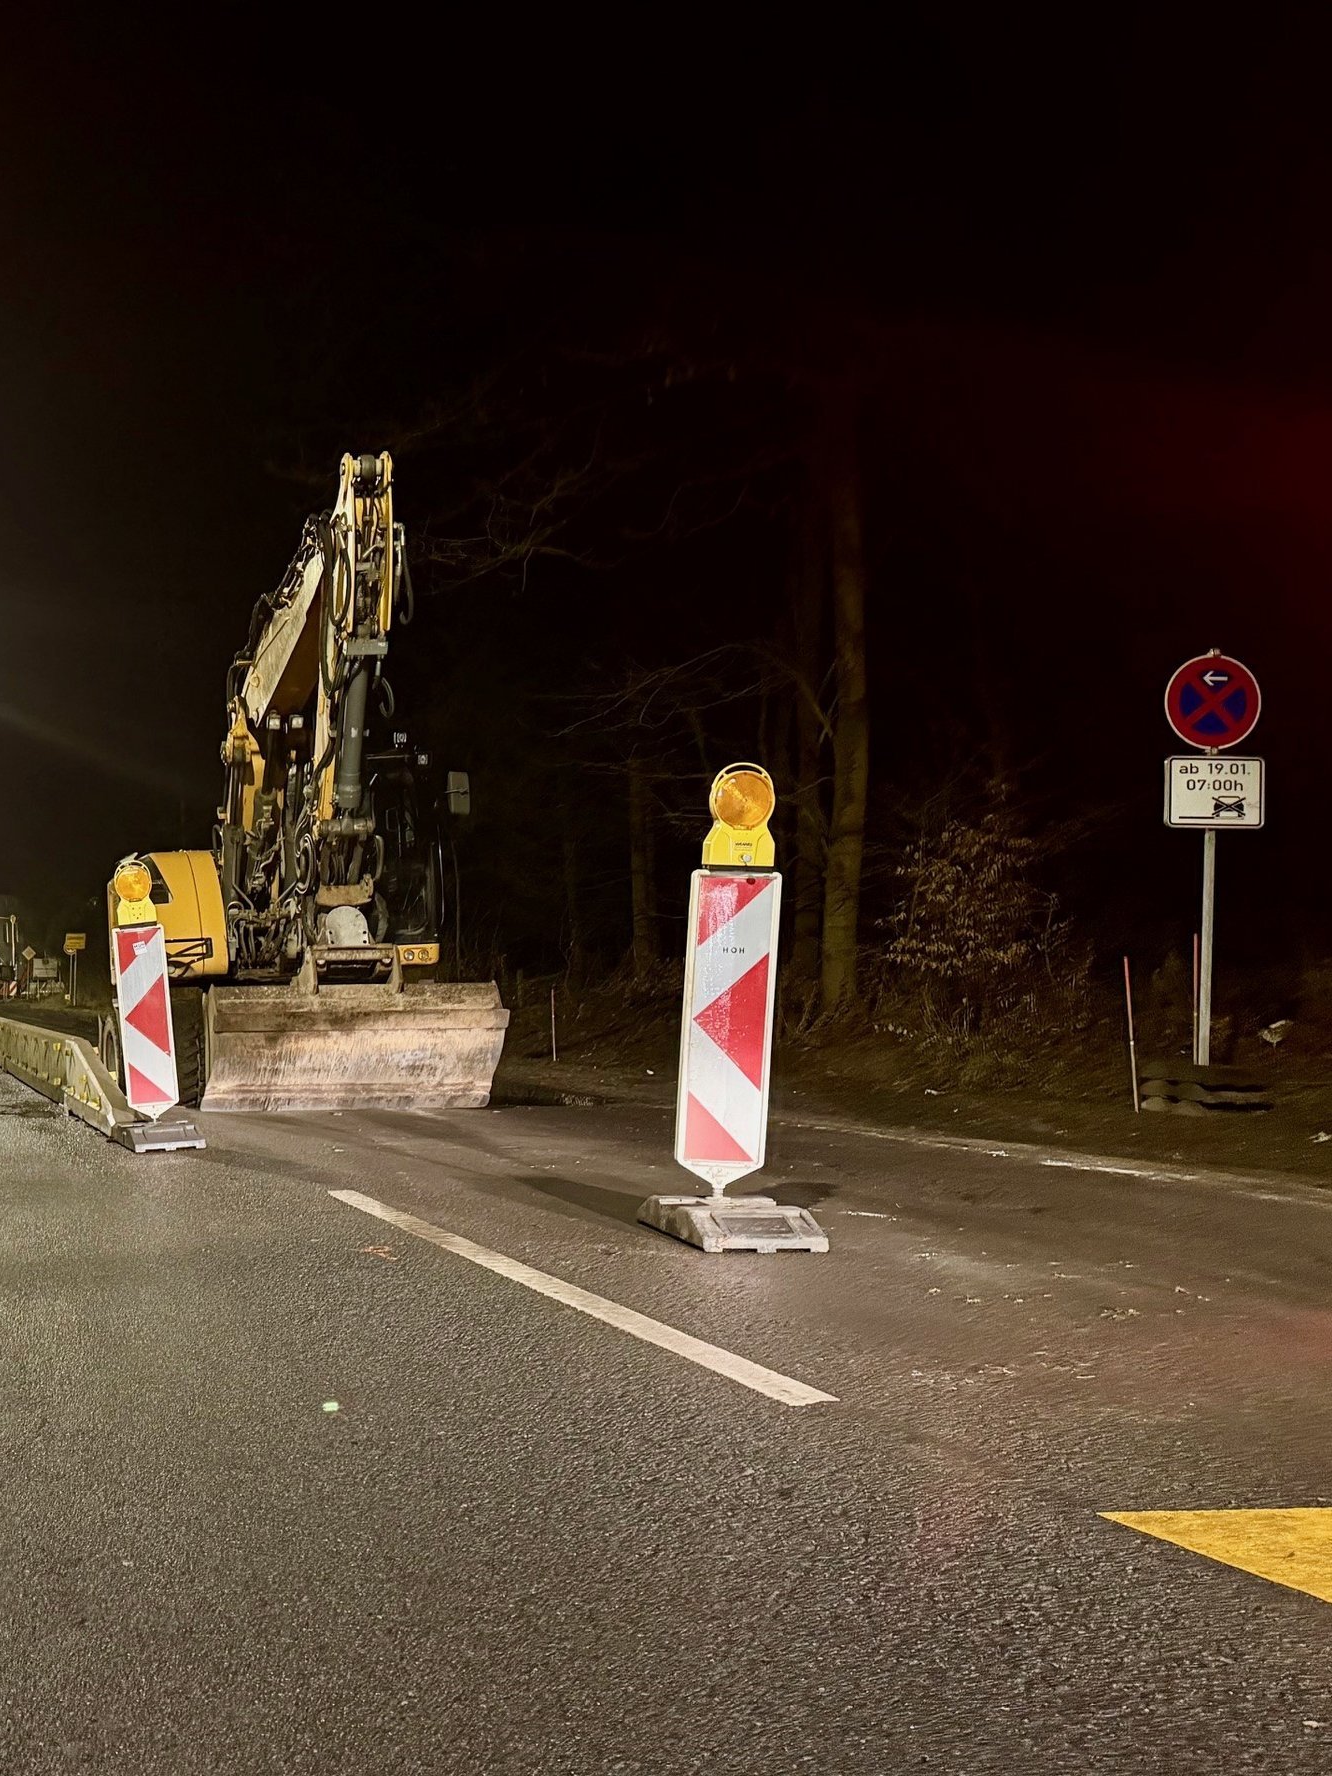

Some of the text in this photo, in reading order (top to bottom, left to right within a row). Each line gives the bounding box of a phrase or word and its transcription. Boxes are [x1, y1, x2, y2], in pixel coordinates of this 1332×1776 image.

[1179, 763, 1250, 775] ab 19.01.
[1187, 779, 1244, 791] 07:00h
